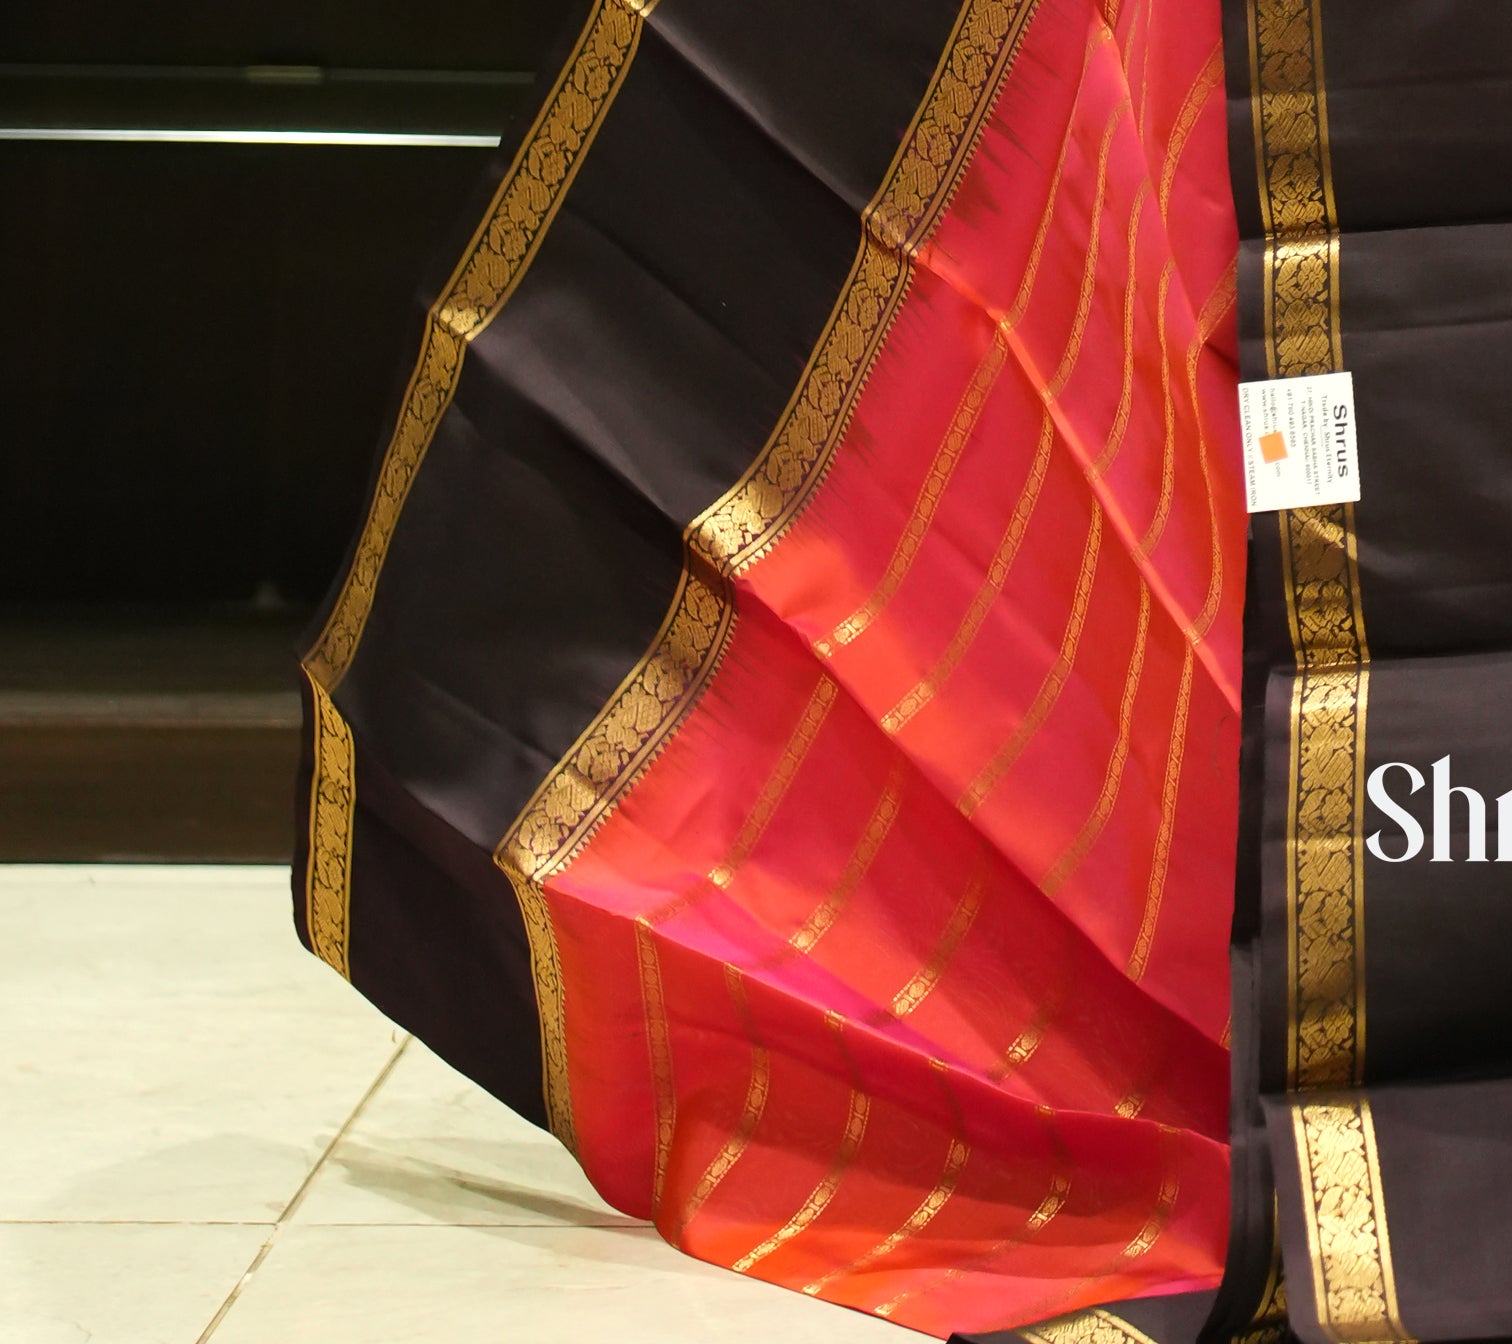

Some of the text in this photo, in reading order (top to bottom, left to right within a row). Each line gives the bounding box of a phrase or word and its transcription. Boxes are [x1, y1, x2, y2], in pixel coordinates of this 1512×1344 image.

[1242, 388, 1250, 403] DRY
[1243, 405, 1252, 431] CLEAN
[1245, 432, 1254, 452] ONLY
[1333, 404, 1348, 478] Shrus
[1248, 461, 1256, 486] STEAM
[1325, 454, 1333, 483] Eternity
[1249, 487, 1257, 507] IRON
